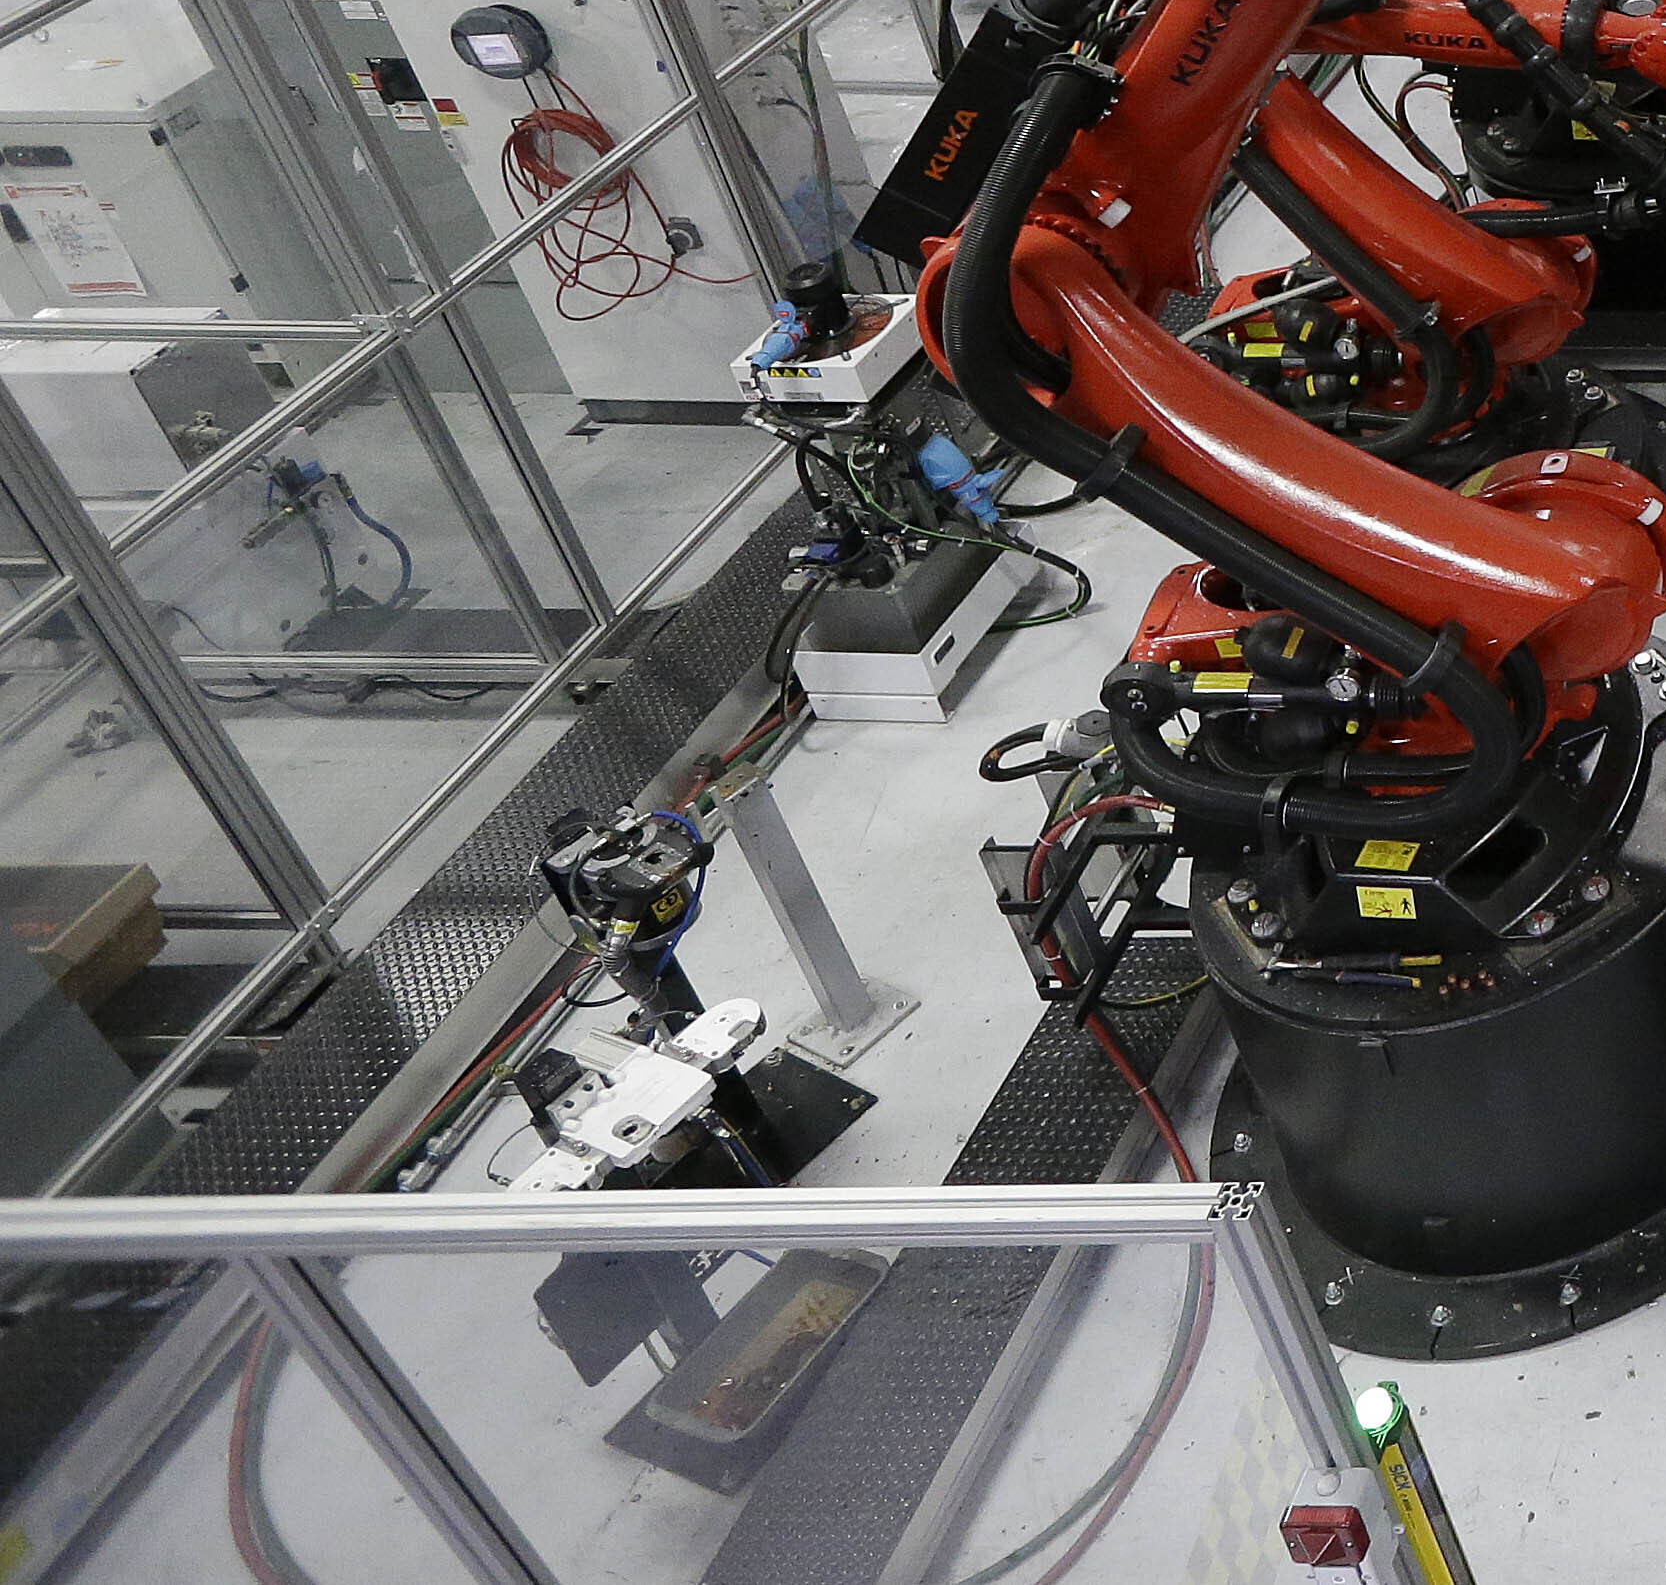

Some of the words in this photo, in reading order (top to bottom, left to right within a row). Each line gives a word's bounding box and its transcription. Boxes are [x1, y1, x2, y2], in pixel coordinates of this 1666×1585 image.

[1404, 32, 1488, 50] KUKA
[924, 109, 978, 182] KUKA
[1388, 1463, 1412, 1491] SICK
